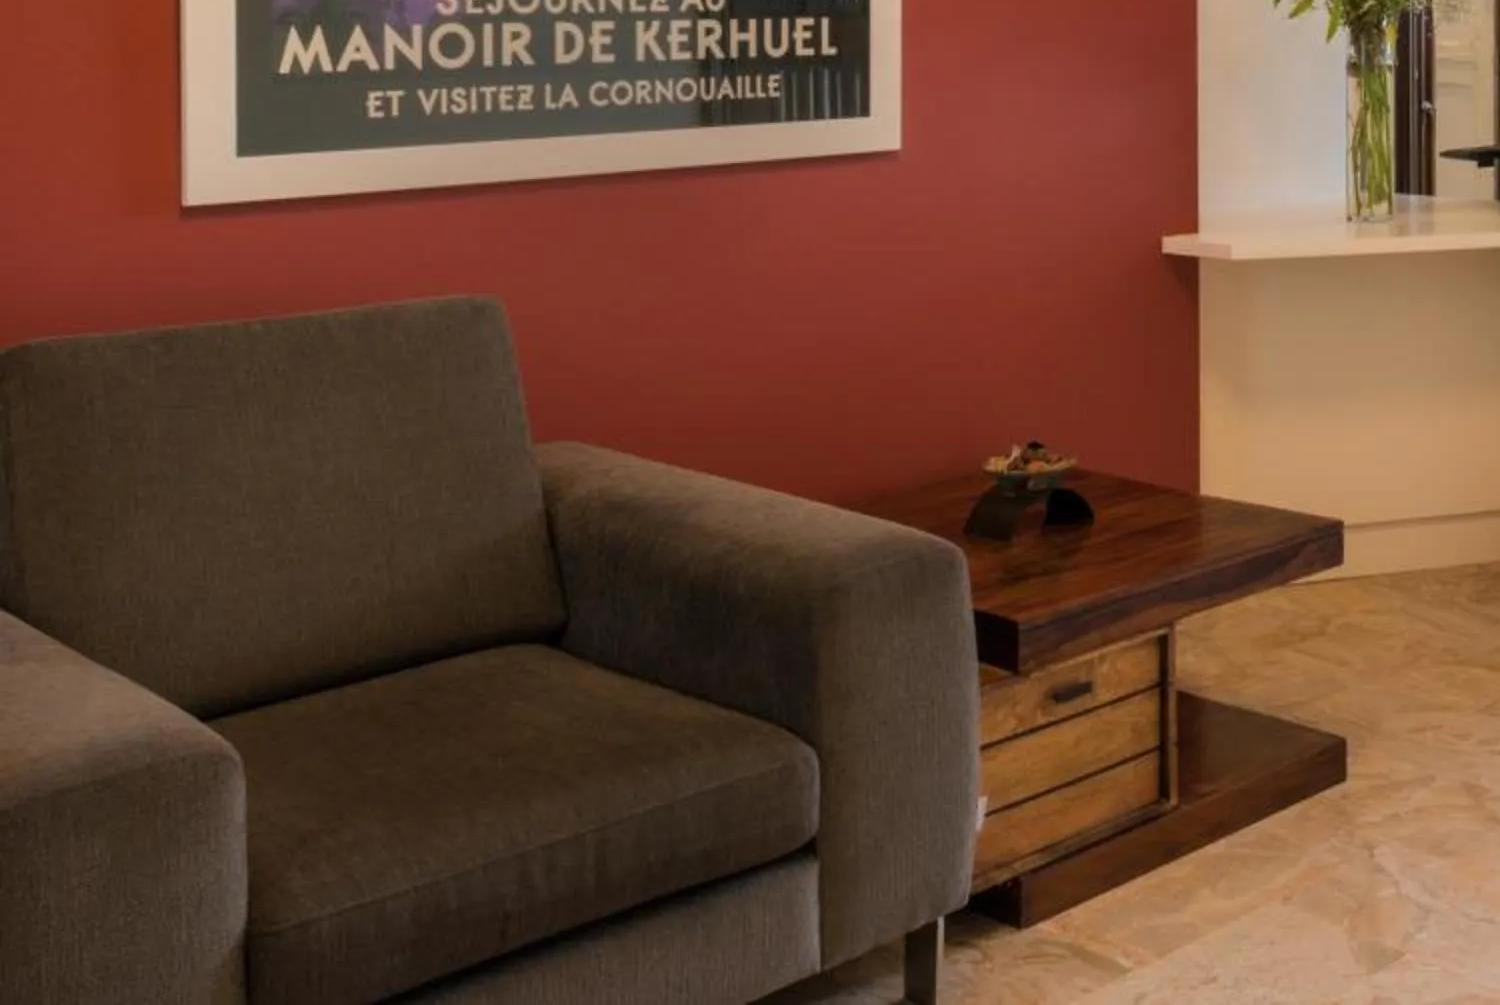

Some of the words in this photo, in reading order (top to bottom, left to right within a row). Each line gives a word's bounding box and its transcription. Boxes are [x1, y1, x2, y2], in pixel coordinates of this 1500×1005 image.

[278, 22, 535, 75] MANOIR
[554, 20, 616, 65] DE
[635, 17, 838, 62] KERHUEL
[365, 90, 405, 119] ET
[417, 84, 534, 116] VISITEZ
[544, 83, 579, 110] LA
[588, 74, 782, 107] CORNOUAILLE
